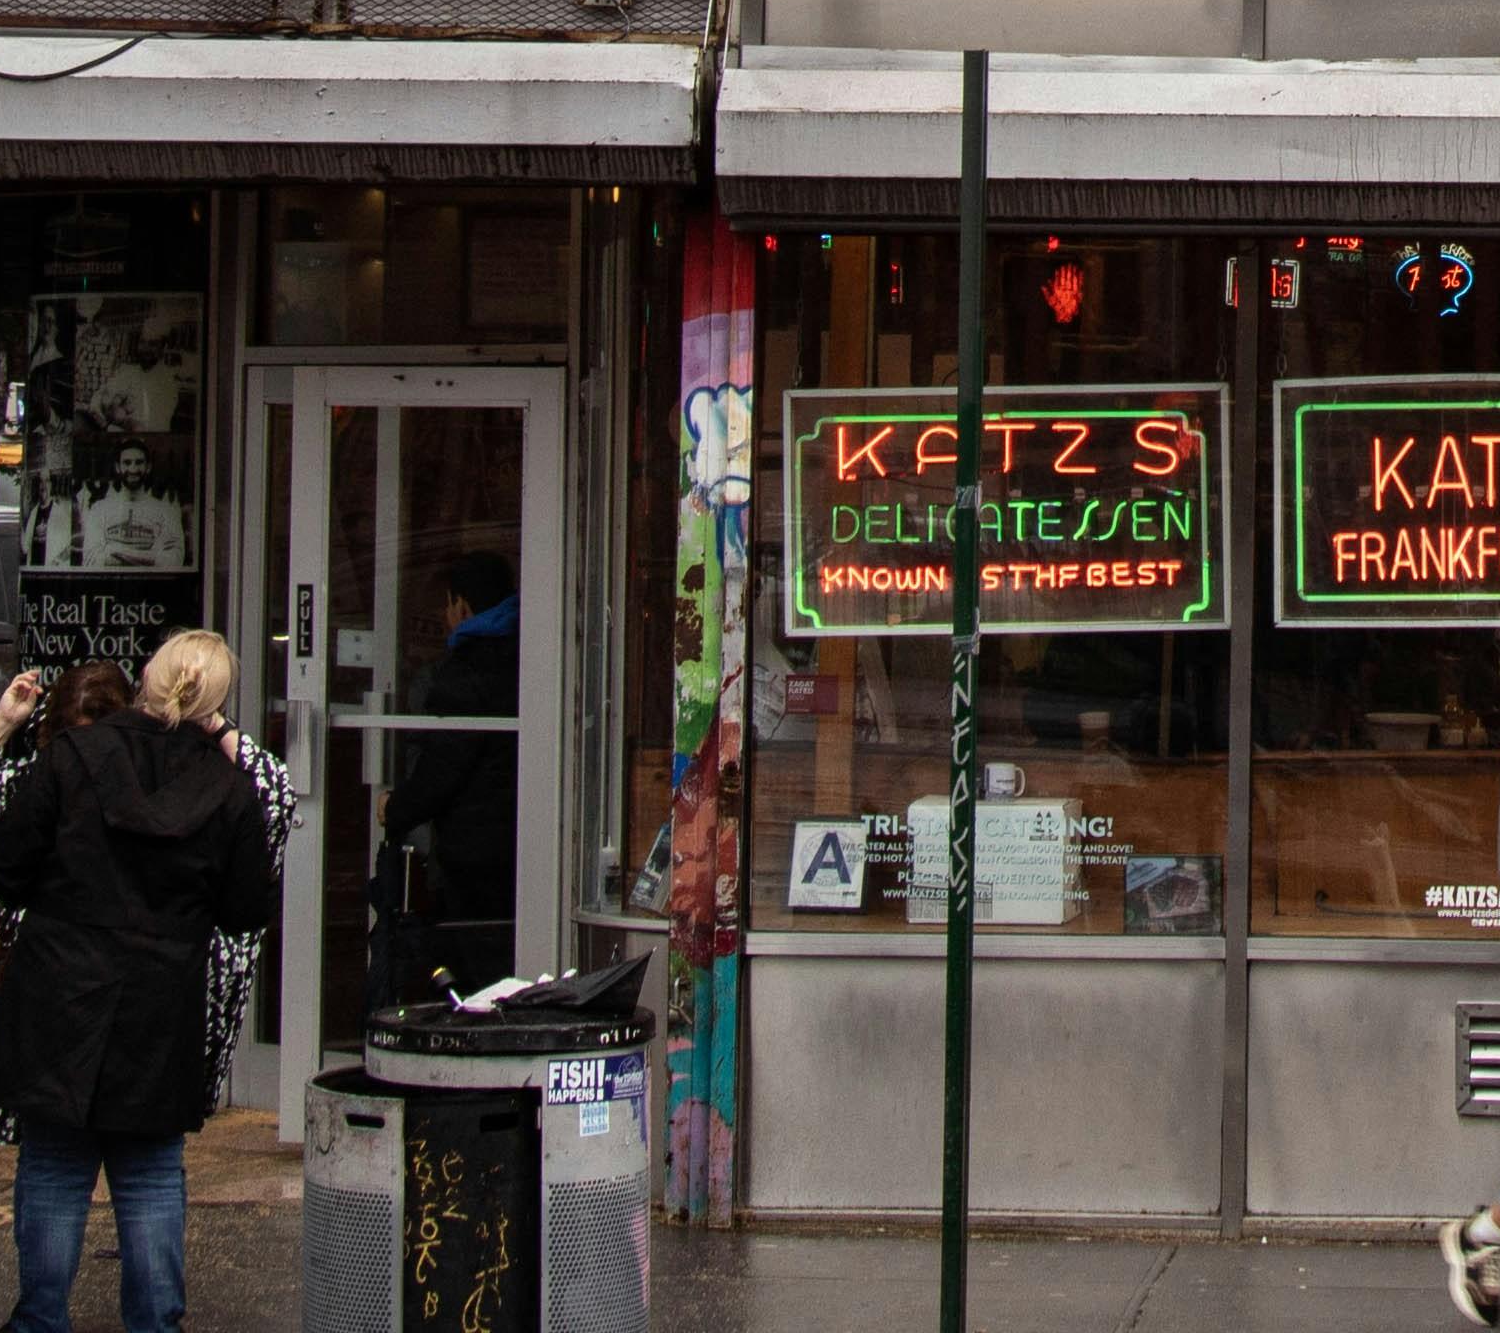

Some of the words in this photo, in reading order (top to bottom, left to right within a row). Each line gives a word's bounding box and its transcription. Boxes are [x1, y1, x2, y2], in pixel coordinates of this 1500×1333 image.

[822, 564, 947, 592] KNOWN
[1086, 559, 1182, 588] BEST
[42, 594, 87, 625] Real
[93, 595, 165, 626] Taste
[300, 590, 311, 651] PULL
[32, 627, 77, 656] New
[81, 627, 152, 657] York.
[861, 815, 950, 837] TRI-STA
[984, 814, 1114, 837] CATERING!
[801, 831, 852, 884] A
[883, 854, 902, 864] HOT
[1066, 854, 1083, 865] THE
[1085, 854, 1128, 865] TRI-STATE
[887, 843, 903, 853] ALL
[1084, 844, 1105, 854] AND
[1107, 844, 1134, 854] LOVE!
[549, 1059, 606, 1101] FISH!
[549, 1090, 595, 1103] HAPPENS
